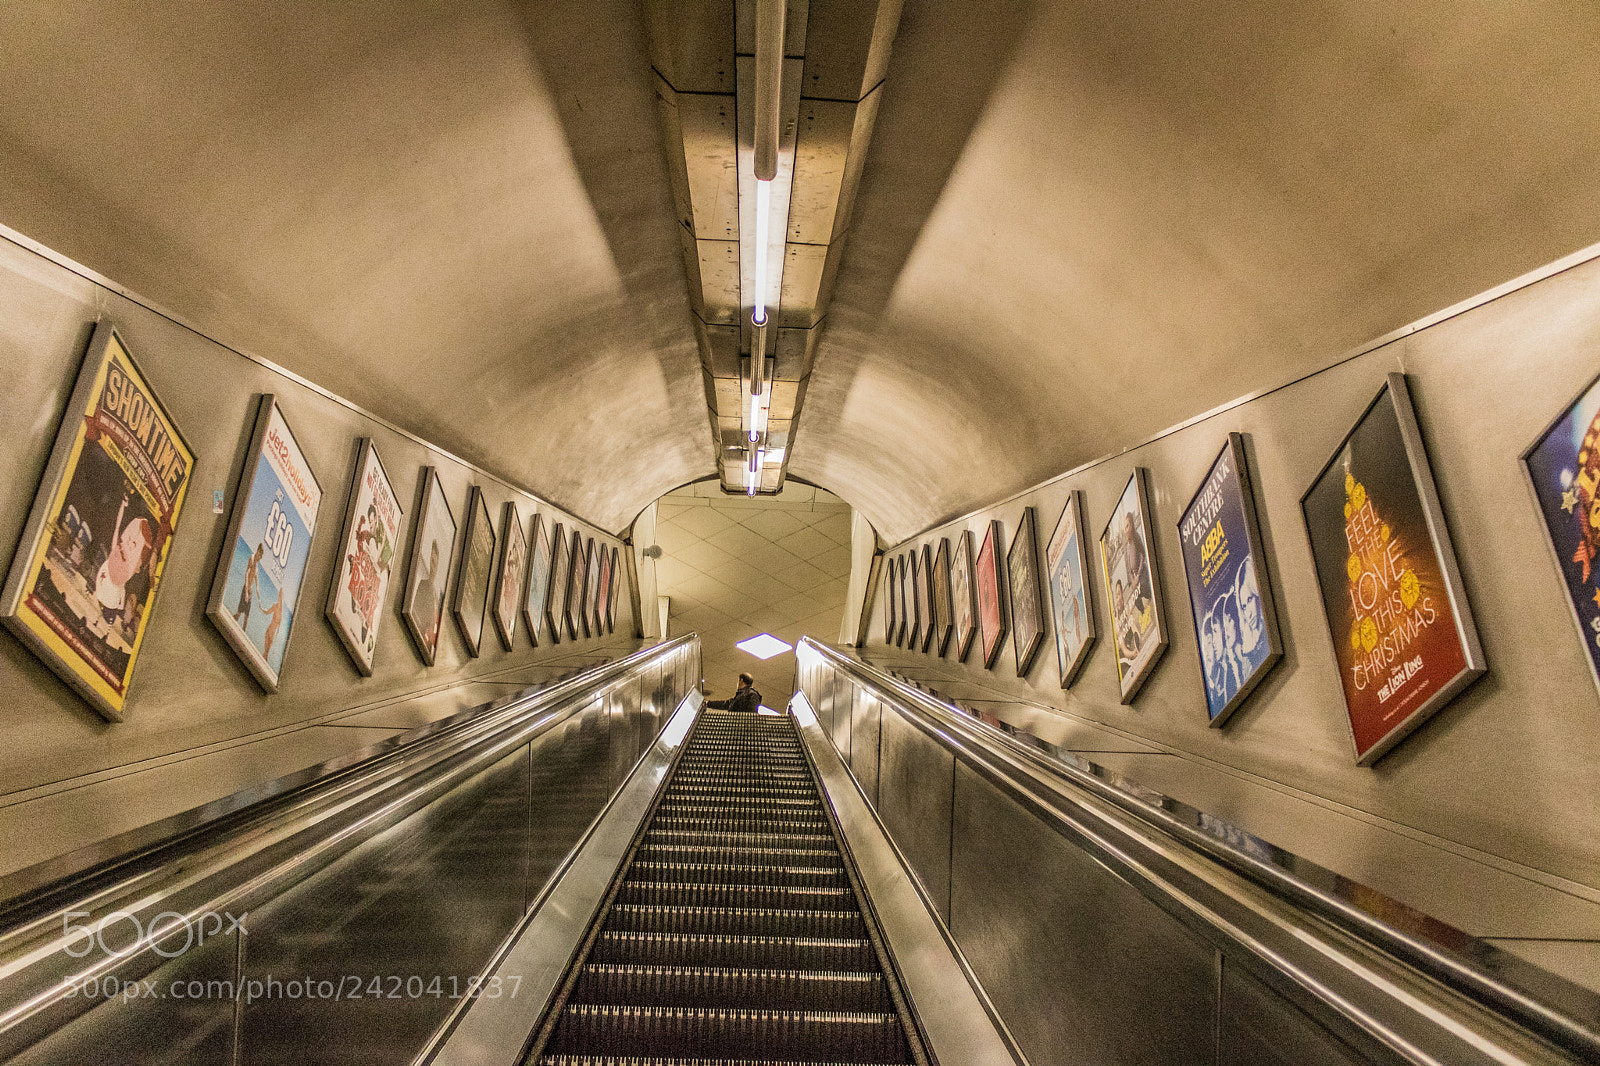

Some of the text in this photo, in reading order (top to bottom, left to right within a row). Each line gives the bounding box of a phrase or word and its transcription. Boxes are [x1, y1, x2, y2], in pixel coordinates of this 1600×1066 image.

[106, 370, 183, 496] SHOWTIME
[1182, 457, 1230, 543] SOUTHBANK
[1192, 490, 1225, 546] CENTRE
[1345, 500, 1380, 553] FEEL
[264, 500, 293, 568] £60
[1201, 520, 1225, 568] ABBA
[1358, 528, 1383, 564] THE
[1349, 539, 1405, 621] LOVE
[1371, 590, 1402, 634] THIS
[1353, 597, 1436, 690] CHRISTMAS
